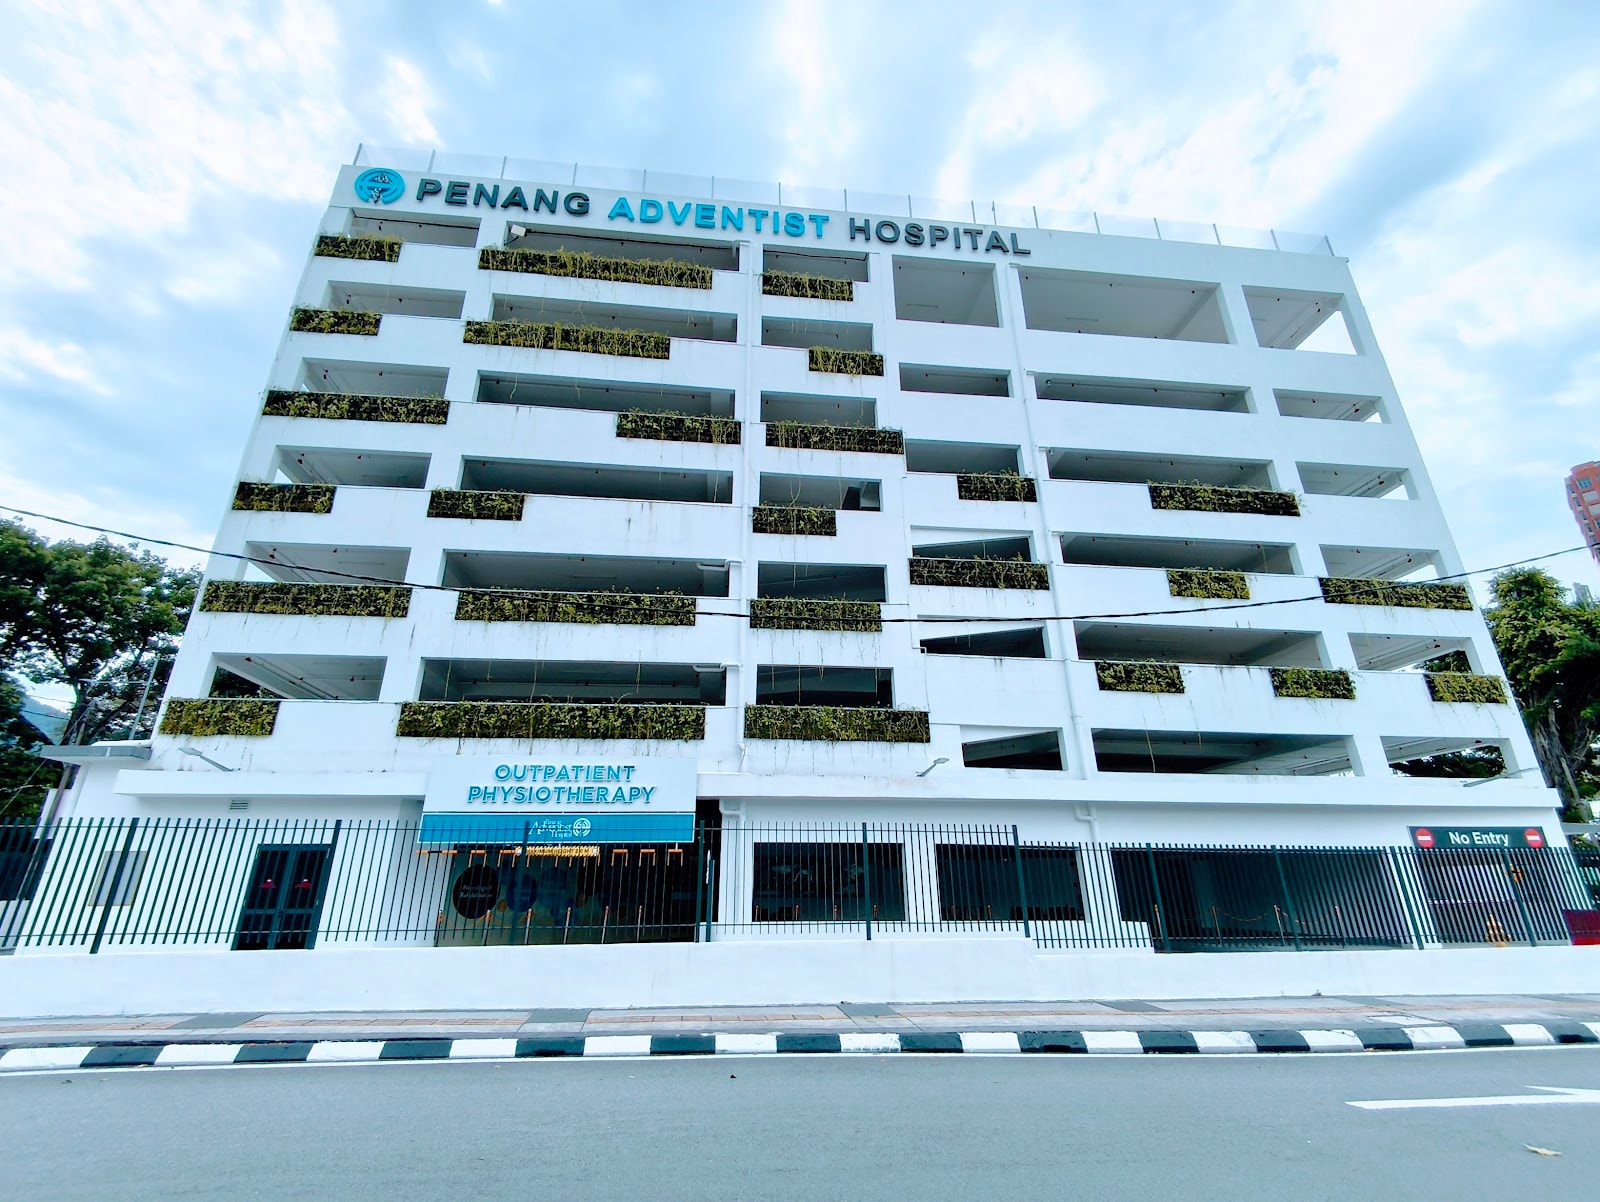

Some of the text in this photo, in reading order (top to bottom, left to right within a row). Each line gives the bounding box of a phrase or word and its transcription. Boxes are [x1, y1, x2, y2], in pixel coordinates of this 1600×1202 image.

[416, 178, 1031, 255] PENANG ADVENTIST HOSPITAL
[494, 764, 635, 781] OUTPATIENT
[467, 786, 655, 804] PHYSIOTHERAPY
[1448, 832, 1509, 847] No Entry
